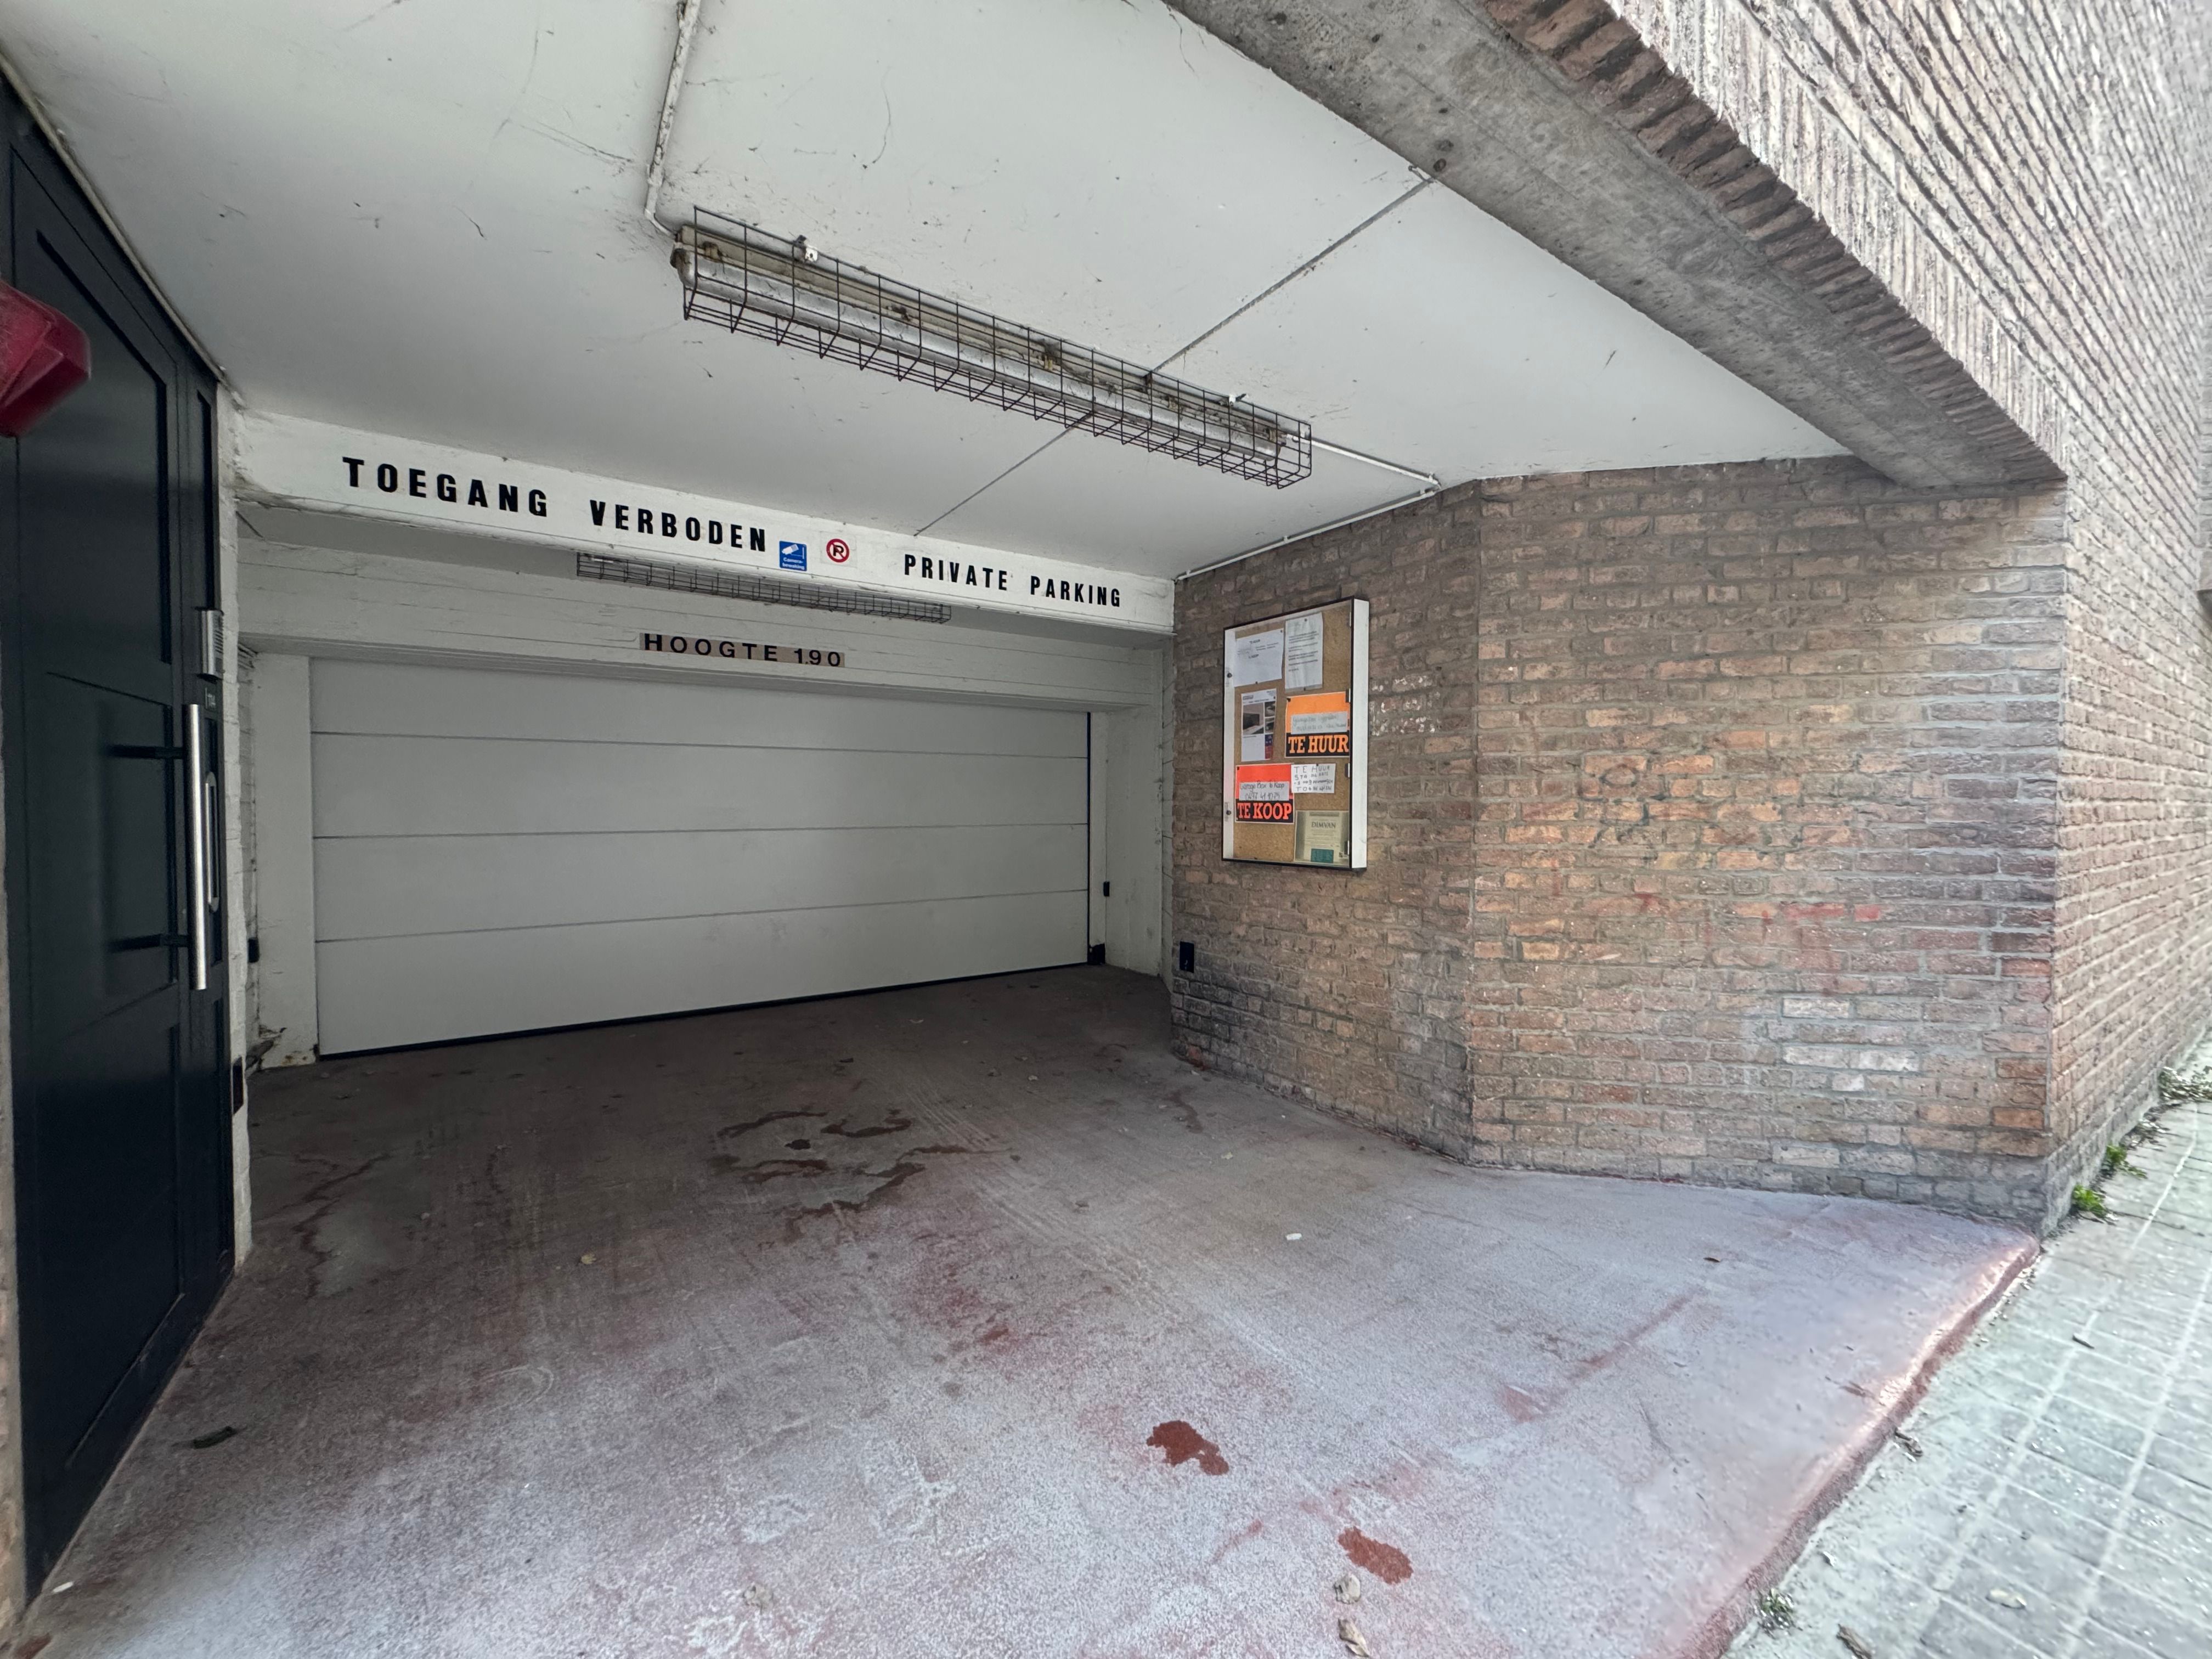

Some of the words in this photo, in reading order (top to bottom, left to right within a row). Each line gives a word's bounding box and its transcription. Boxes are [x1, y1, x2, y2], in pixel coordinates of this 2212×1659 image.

[342, 456, 548, 517] TOEGANG
[589, 499, 766, 552] VERBODEN
[904, 554, 1008, 591] PRIVATE
[1030, 575, 1120, 607] PARKING
[644, 633, 778, 663] HOOGTE
[1288, 736, 1306, 754] TE
[1307, 734, 1349, 753] HUUR
[1237, 802, 1251, 819] TE
[1252, 802, 1292, 820] KOOP
